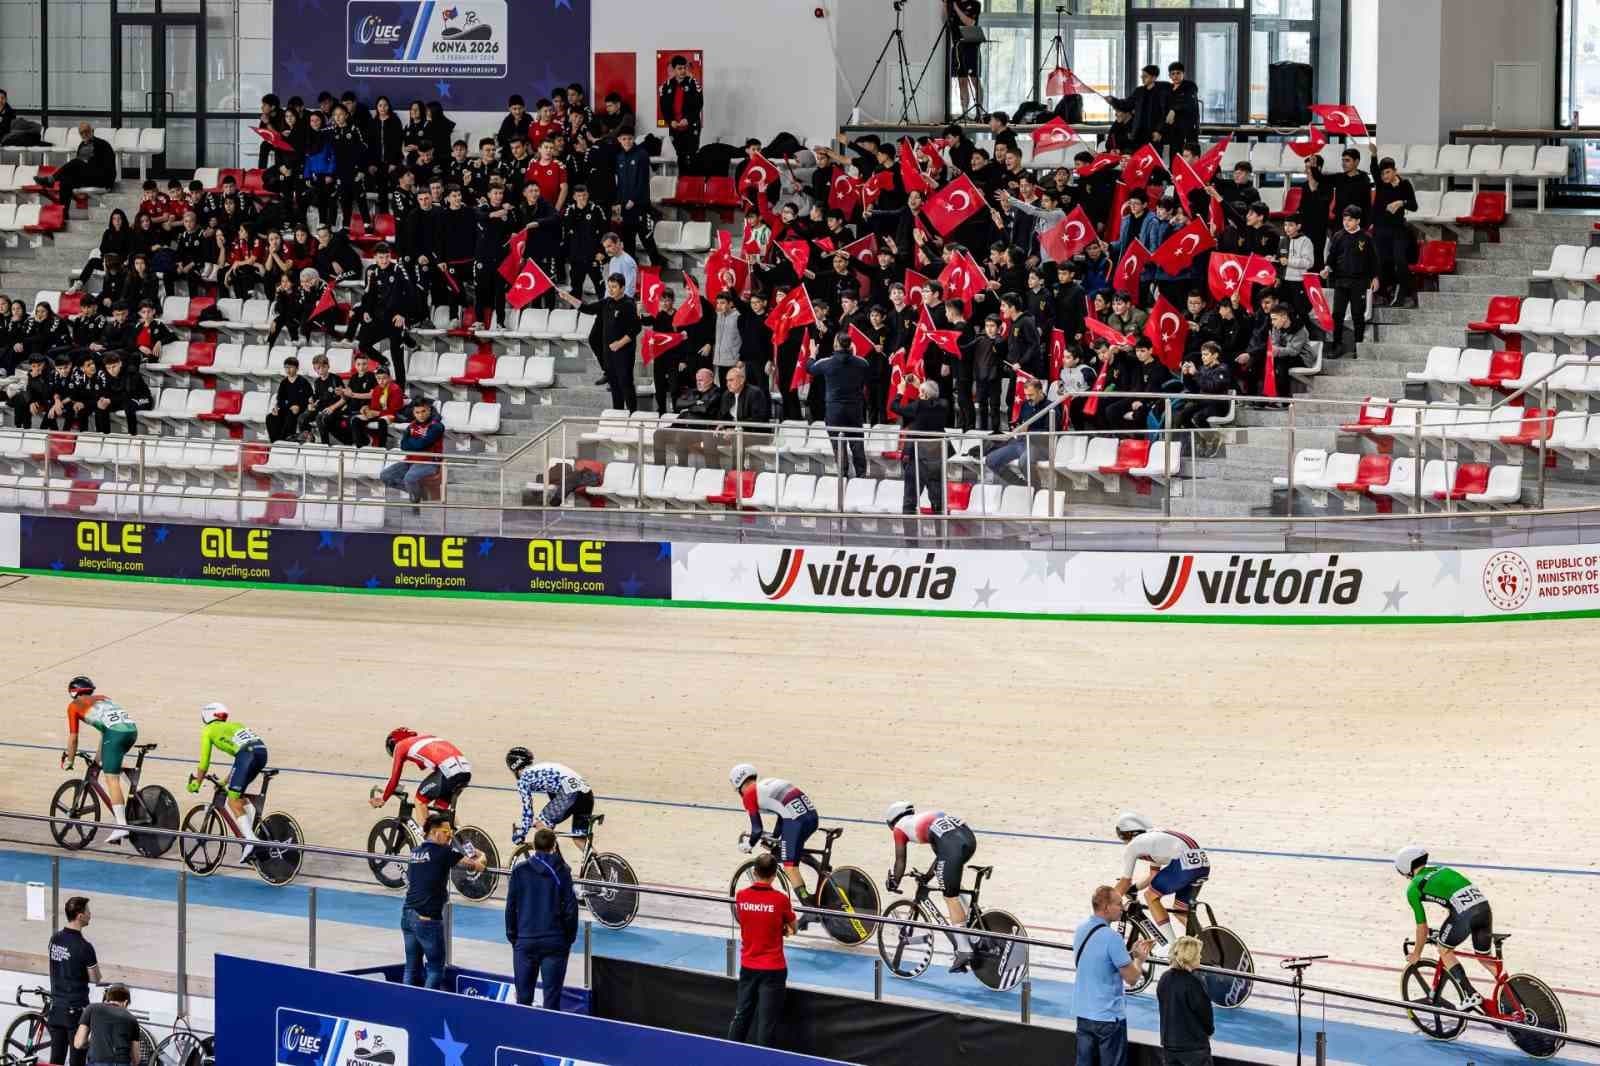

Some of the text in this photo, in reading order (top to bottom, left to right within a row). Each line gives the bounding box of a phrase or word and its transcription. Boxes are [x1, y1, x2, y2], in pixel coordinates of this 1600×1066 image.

[375, 25, 402, 38] UEC
[432, 41, 500, 53] KONYA 2026
[79, 556, 144, 572] alecycling.com
[1536, 556, 1598, 570] REPUBLIC OF
[202, 563, 270, 579] alecycling.com
[807, 550, 957, 600] vittoria
[1537, 570, 1598, 583] MINISTRY OF
[395, 572, 466, 588] alecycling.com
[530, 577, 605, 593] alecycling.com
[1197, 555, 1363, 605] vittoria
[1538, 584, 1599, 598] AND SPORTS
[1186, 852, 1201, 865] 59
[1456, 889, 1473, 906] 72
[739, 902, 775, 913] TÜRKİYE
[299, 1035, 321, 1050] UEC
